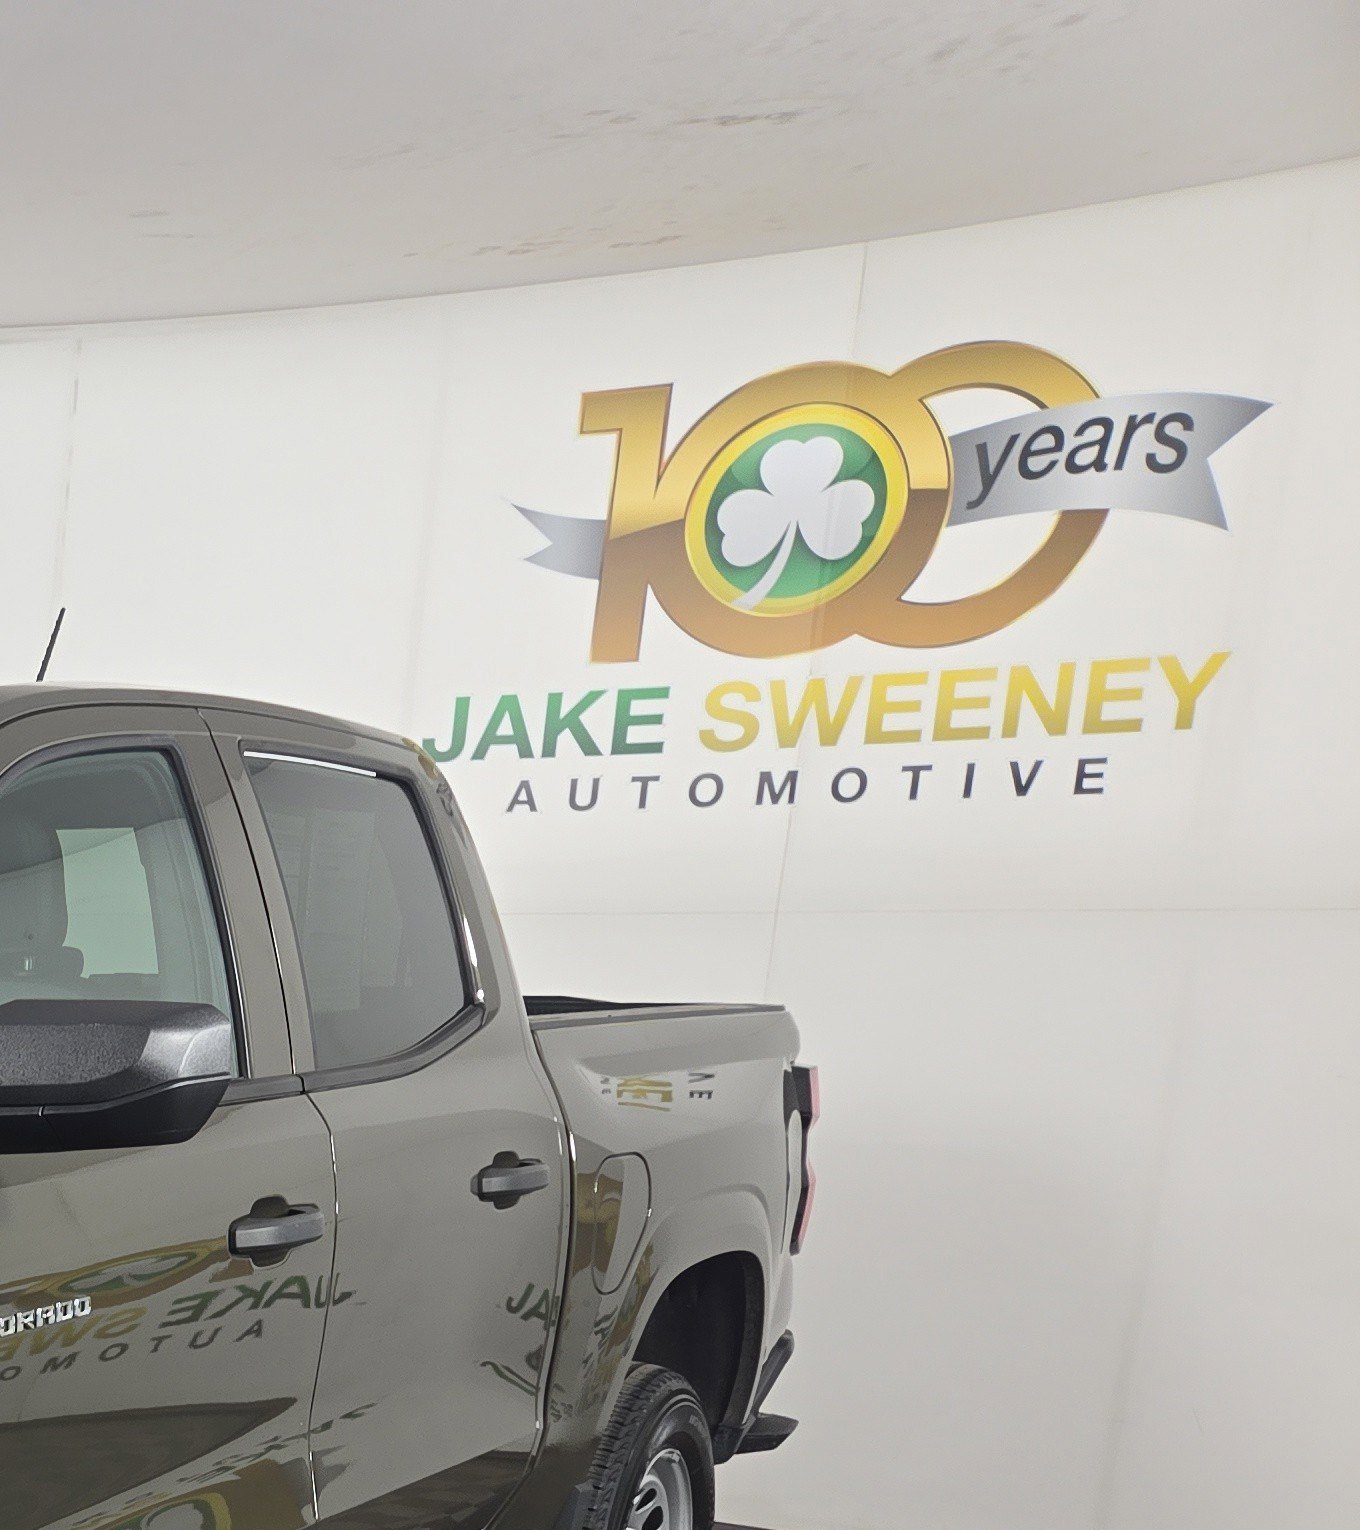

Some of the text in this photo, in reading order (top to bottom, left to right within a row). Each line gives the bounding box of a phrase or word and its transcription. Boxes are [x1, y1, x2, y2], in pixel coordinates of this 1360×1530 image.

[966, 412, 1194, 509] years
[422, 651, 1231, 762] JAKE SWEENEY
[506, 757, 1109, 813] AUTOMOTIVE
